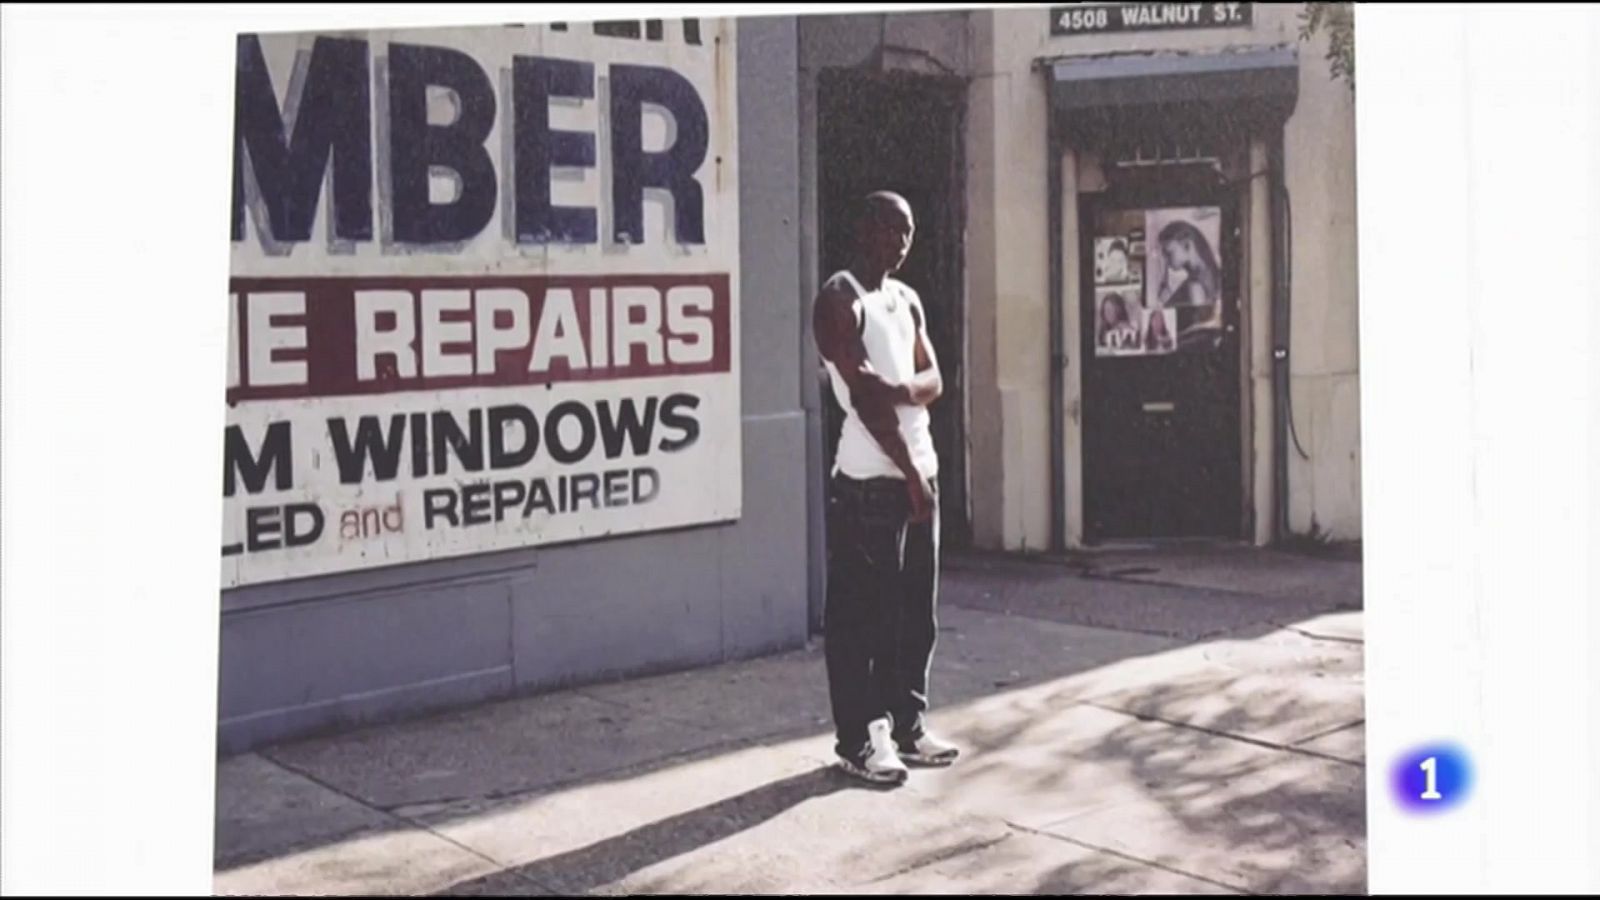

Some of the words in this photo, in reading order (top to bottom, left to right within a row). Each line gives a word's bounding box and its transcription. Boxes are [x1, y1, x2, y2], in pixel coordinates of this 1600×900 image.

[1058, 8, 1108, 30] 4508
[1121, 4, 1202, 26] WALNUT
[1213, 3, 1242, 21] ST.
[231, 33, 710, 252] MBER
[228, 291, 309, 387] E
[353, 286, 714, 382] REPAIRS
[326, 393, 700, 485] WINDOWS
[339, 491, 405, 541] and
[423, 467, 661, 529] REPAIRED
